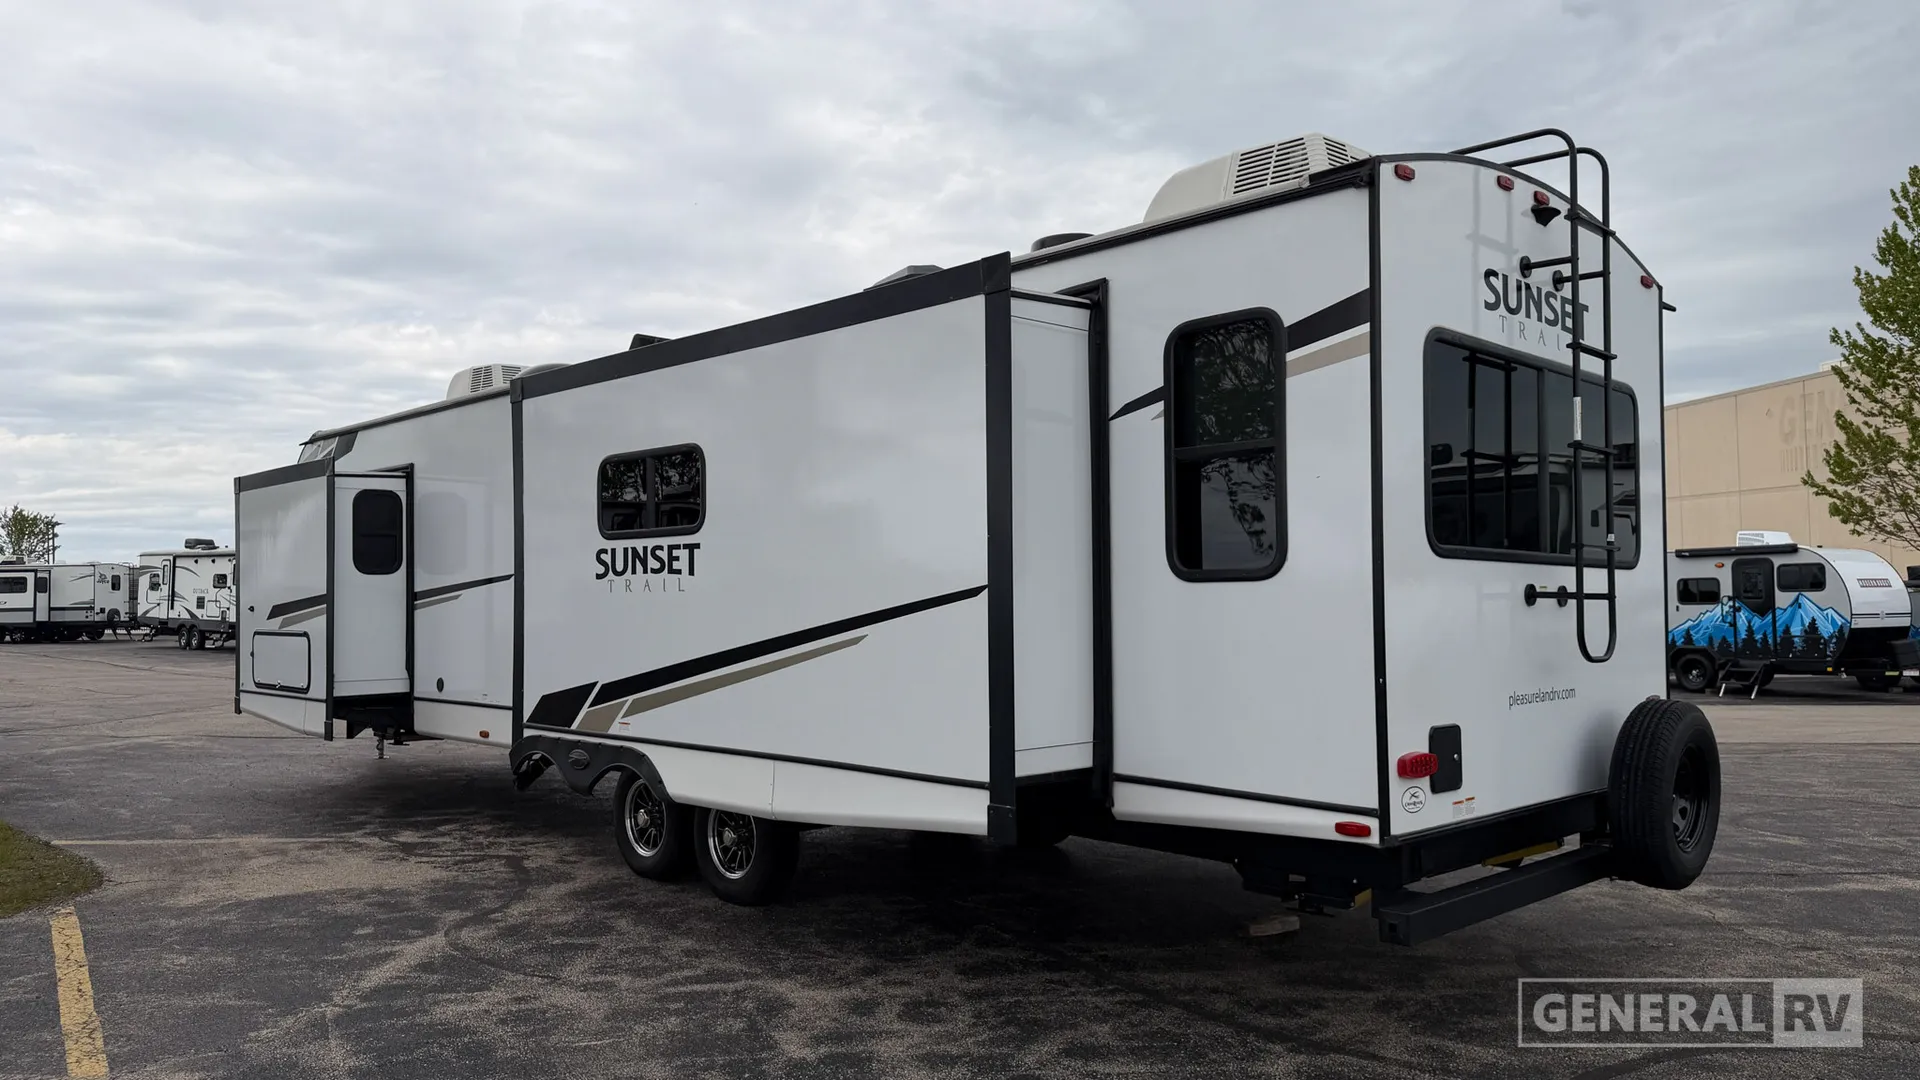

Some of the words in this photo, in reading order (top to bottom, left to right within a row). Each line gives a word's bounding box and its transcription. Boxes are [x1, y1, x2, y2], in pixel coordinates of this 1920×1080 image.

[1483, 268, 1589, 341] SUNSET
[1498, 314, 1573, 353] TRAI
[595, 542, 701, 580] SUNSET
[607, 577, 685, 593] TRAIL
[1508, 686, 1576, 711] pleasurelandrv.com
